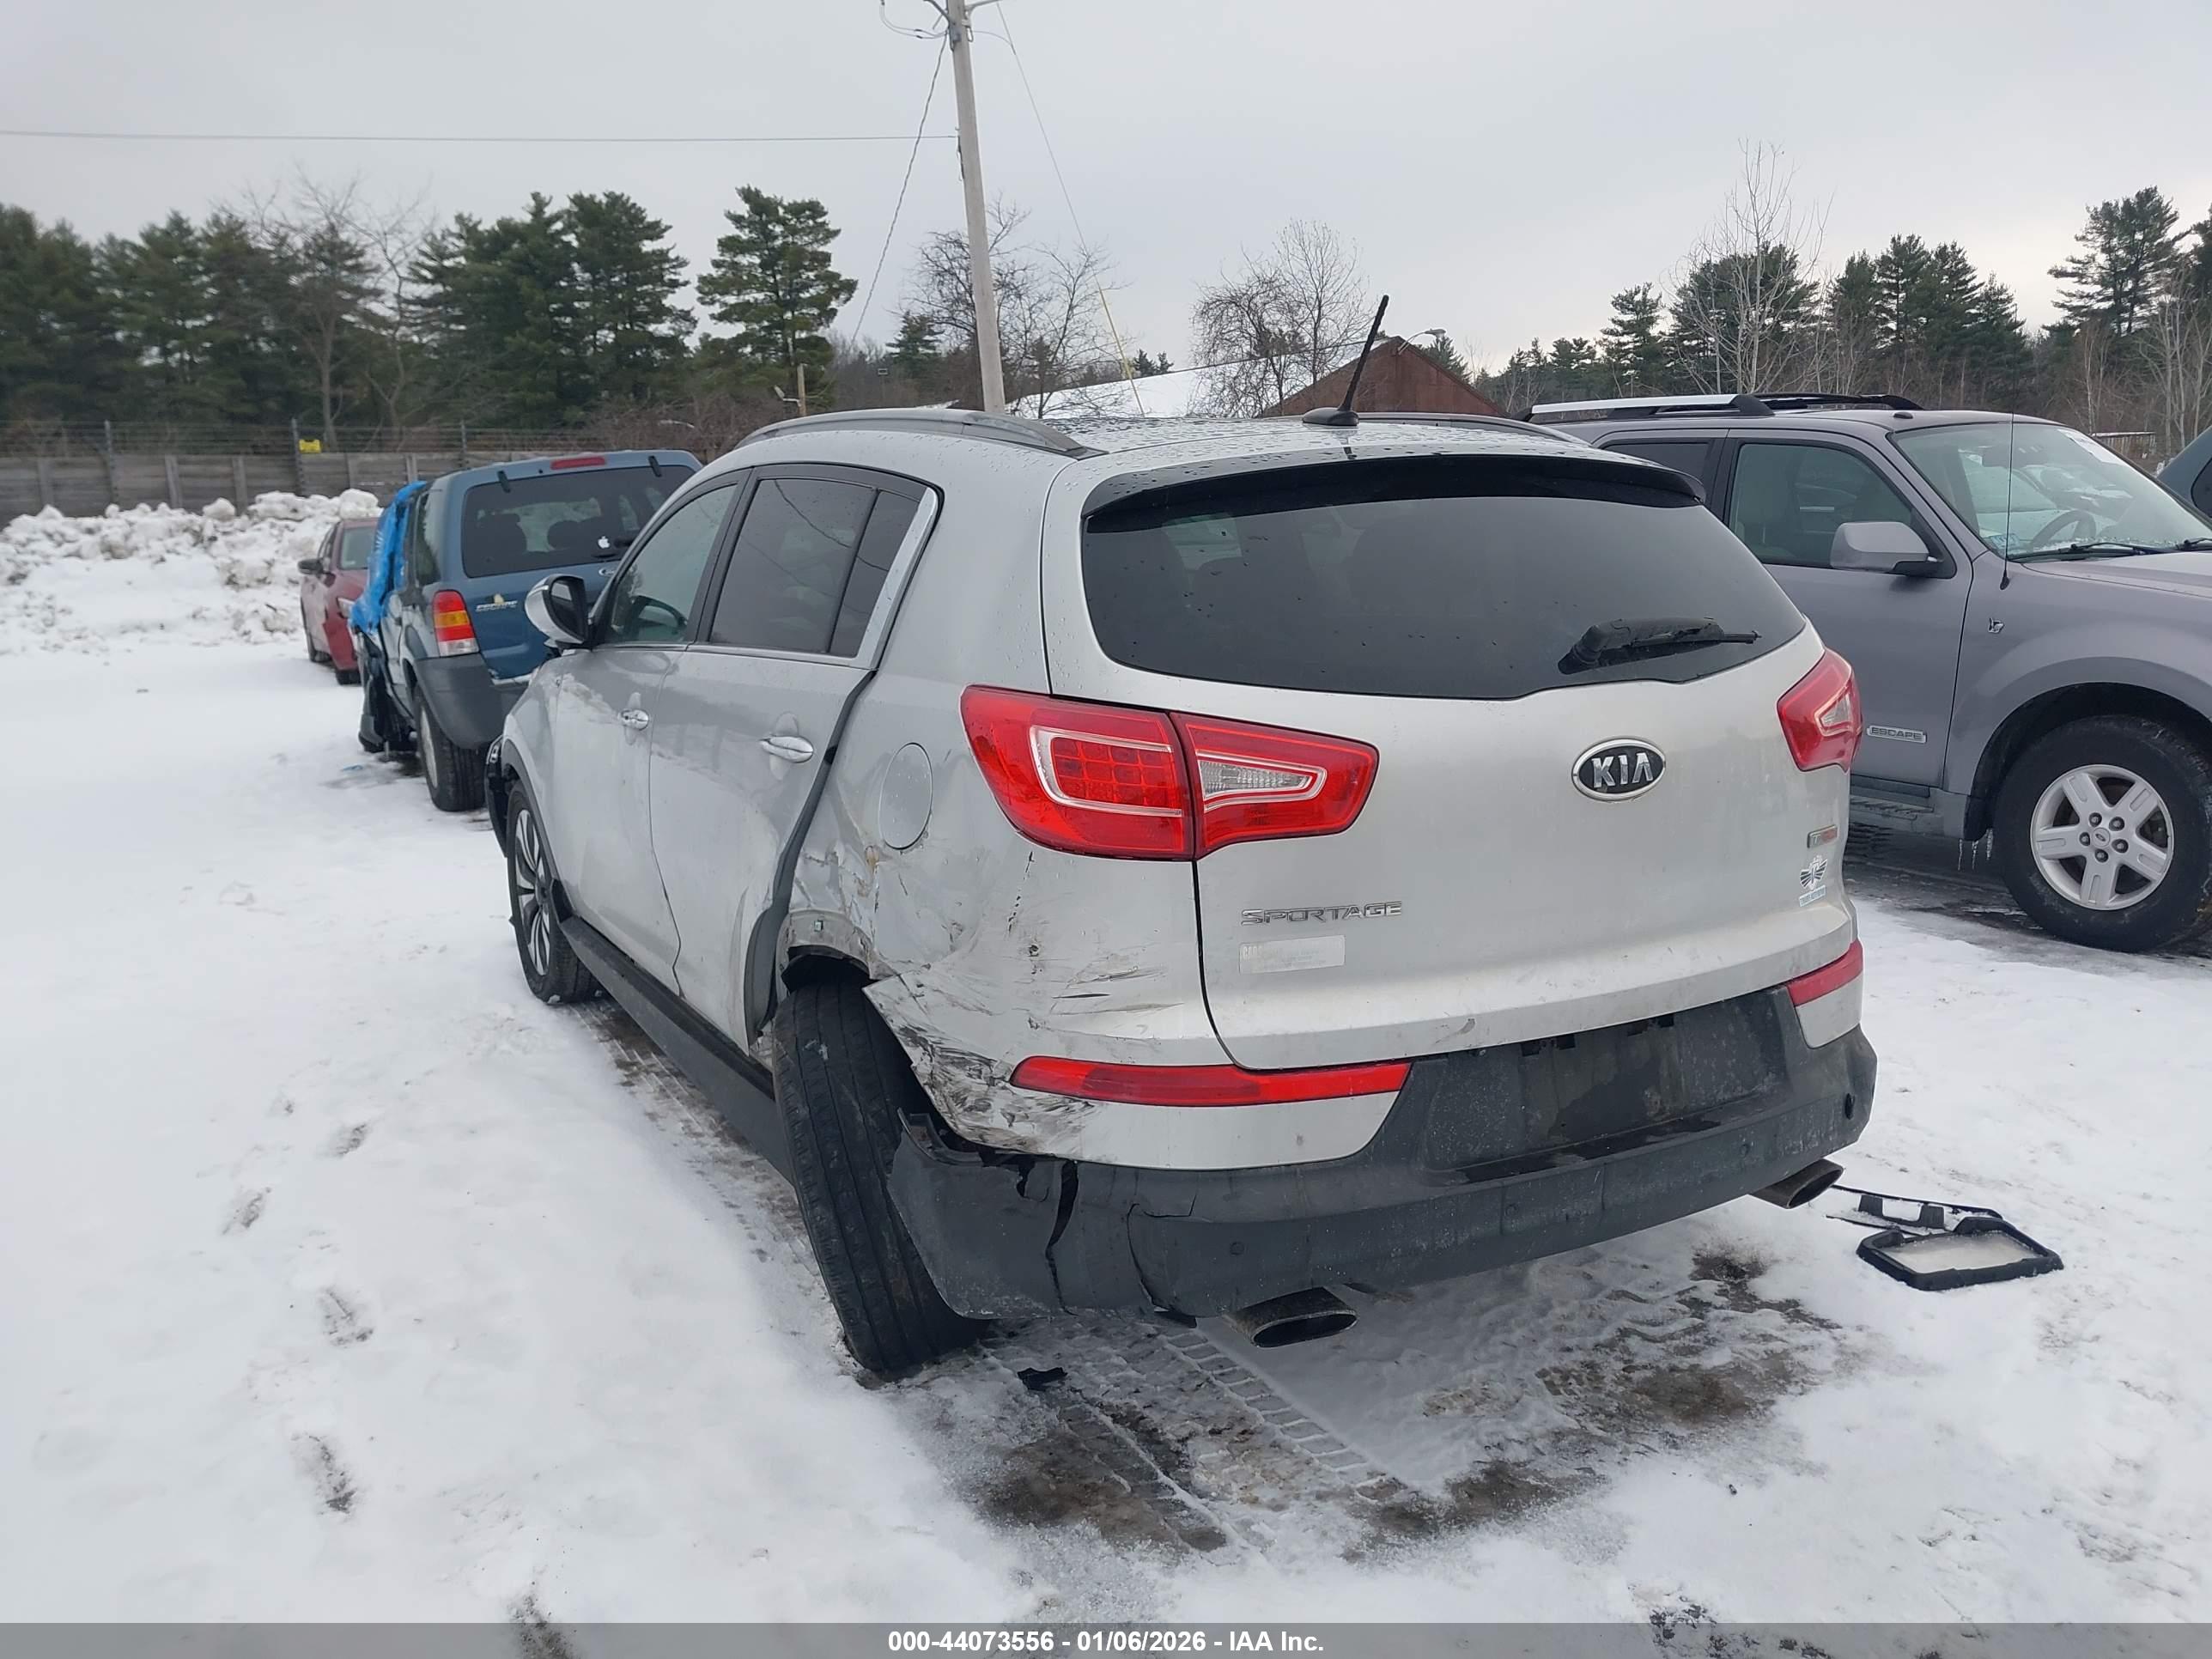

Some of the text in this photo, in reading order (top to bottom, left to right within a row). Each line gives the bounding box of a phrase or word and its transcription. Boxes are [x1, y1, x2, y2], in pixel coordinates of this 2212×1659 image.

[1871, 726, 1923, 740] ESCAPE
[1591, 752, 1654, 788] KIA
[1241, 901, 1402, 926] SPORTAGE
